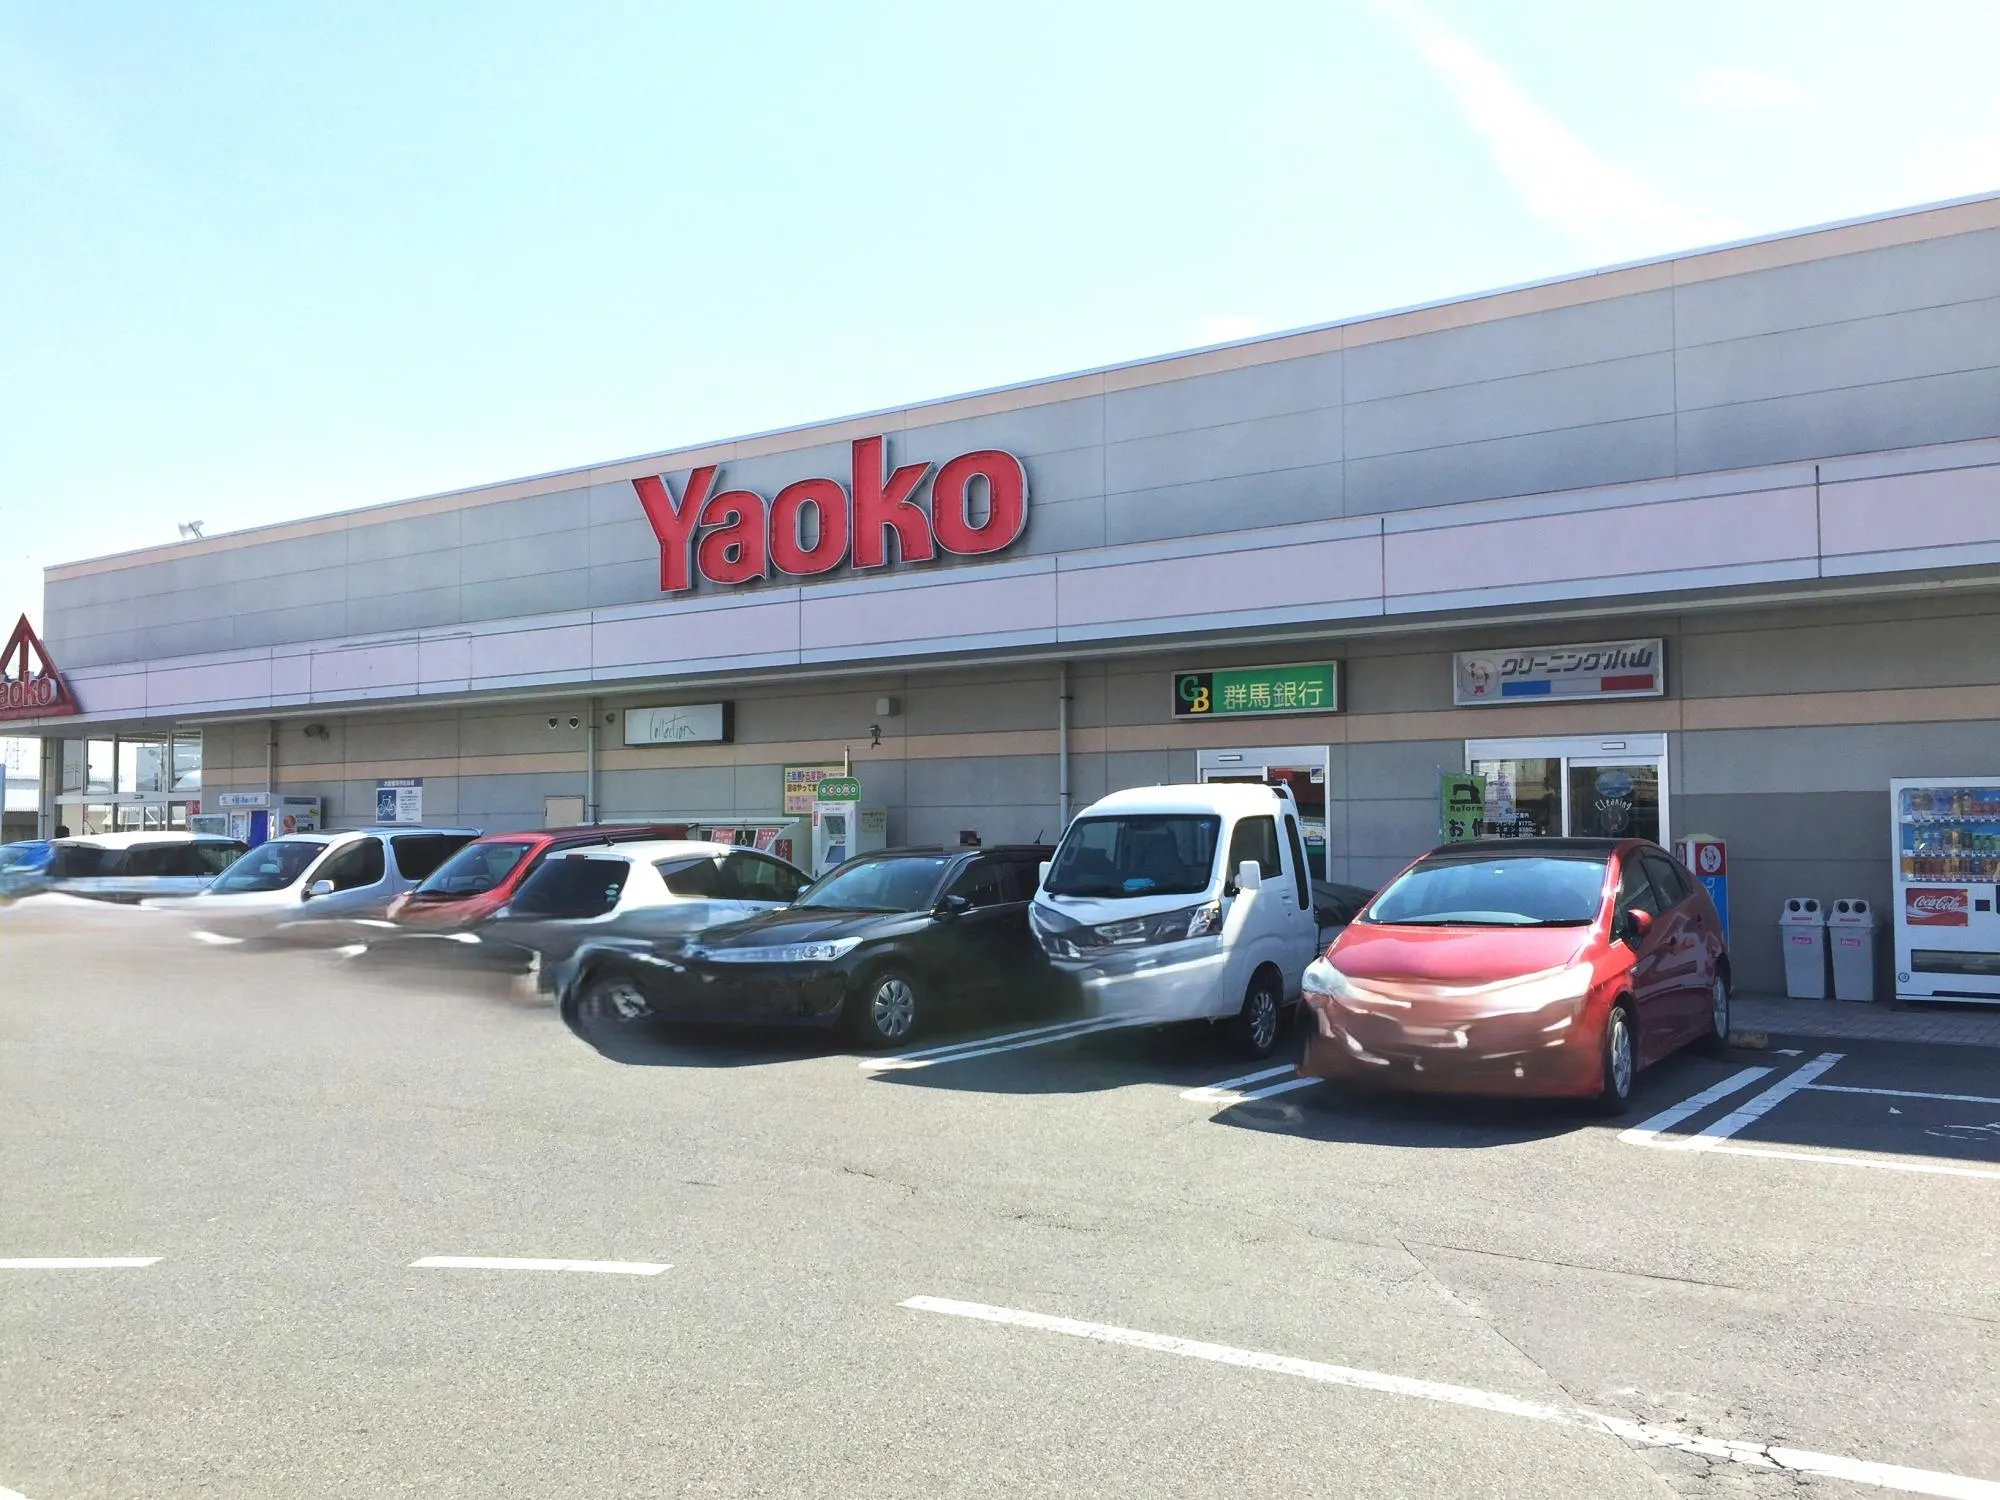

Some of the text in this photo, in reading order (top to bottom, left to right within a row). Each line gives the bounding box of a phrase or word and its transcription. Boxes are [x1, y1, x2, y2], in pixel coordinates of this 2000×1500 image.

[631, 434, 1030, 593] Yaoko
[1501, 647, 1652, 676] クリーニング小山
[0, 670, 57, 709] aoko
[1179, 675, 1209, 712] GB
[1223, 680, 1323, 710] 群馬銀行
[1450, 804, 1484, 812] Reform
[1594, 798, 1633, 811] Cleaning
